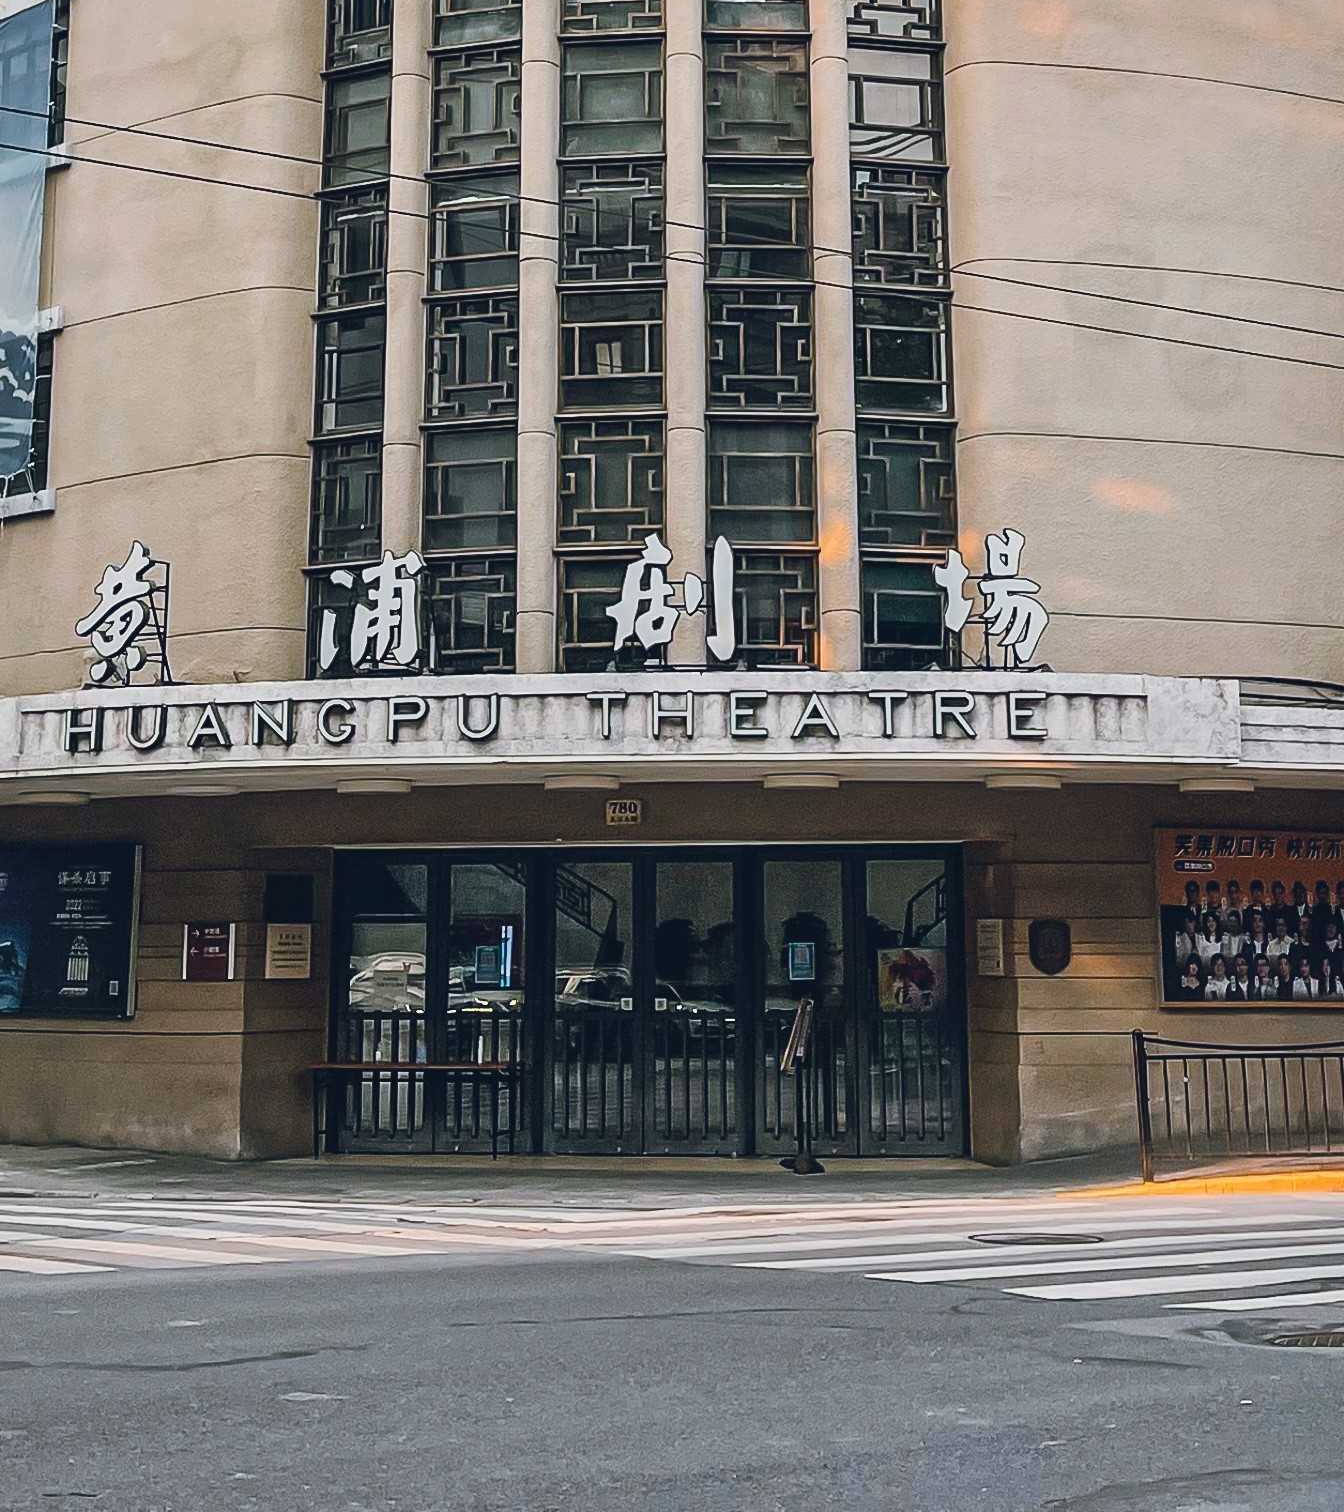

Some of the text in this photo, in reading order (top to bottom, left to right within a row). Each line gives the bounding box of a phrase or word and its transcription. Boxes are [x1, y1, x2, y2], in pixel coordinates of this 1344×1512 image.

[63, 691, 1049, 753] HUANGPU THEATRE
[609, 802, 638, 814] 780
